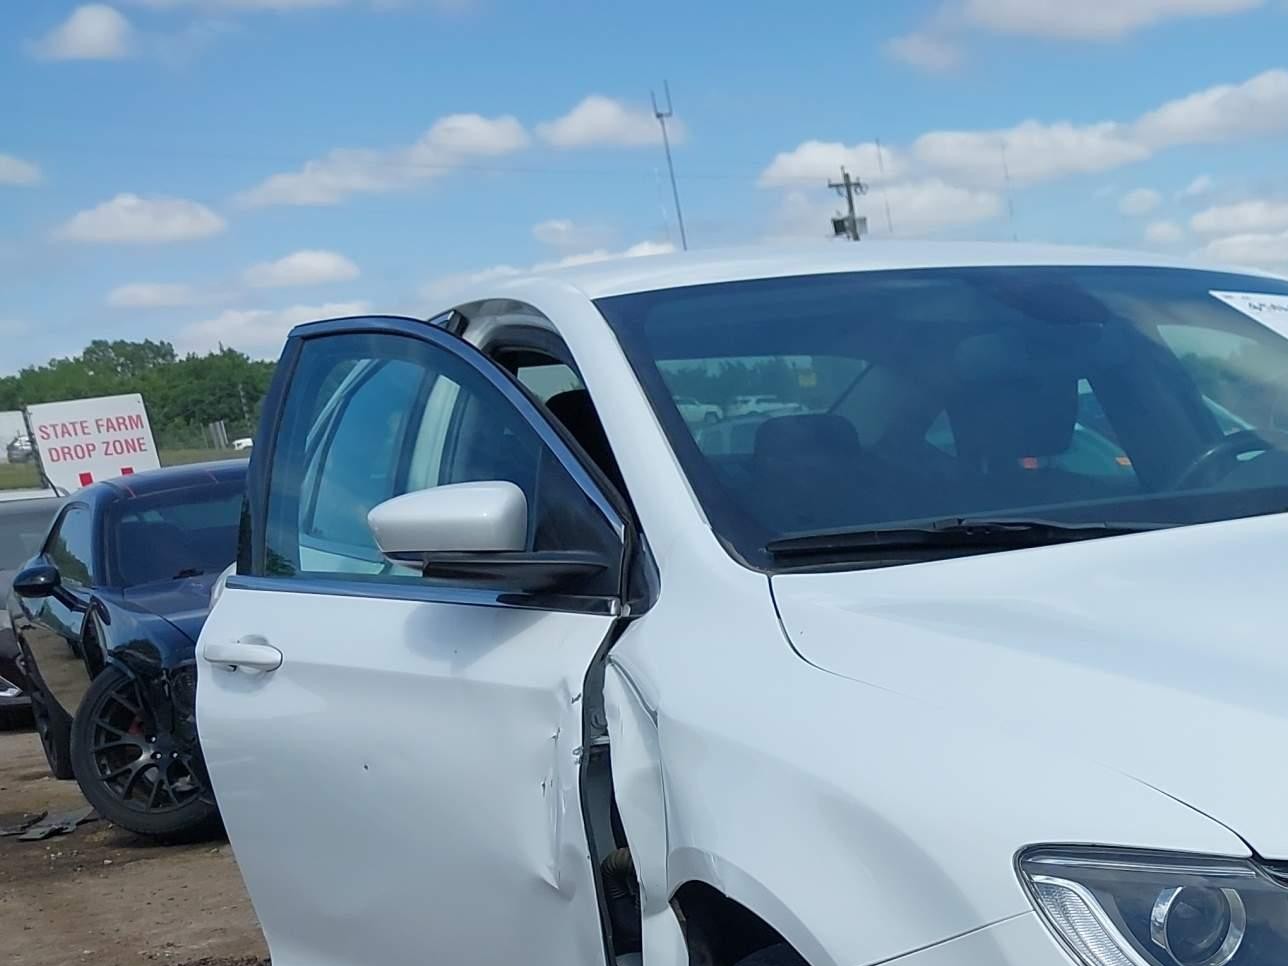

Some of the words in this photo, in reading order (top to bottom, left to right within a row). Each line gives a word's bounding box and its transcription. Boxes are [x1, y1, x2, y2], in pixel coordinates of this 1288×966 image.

[38, 419, 92, 441] STATE
[95, 414, 145, 434] FARM
[48, 441, 97, 463] DROP
[103, 437, 148, 457] ZONE
